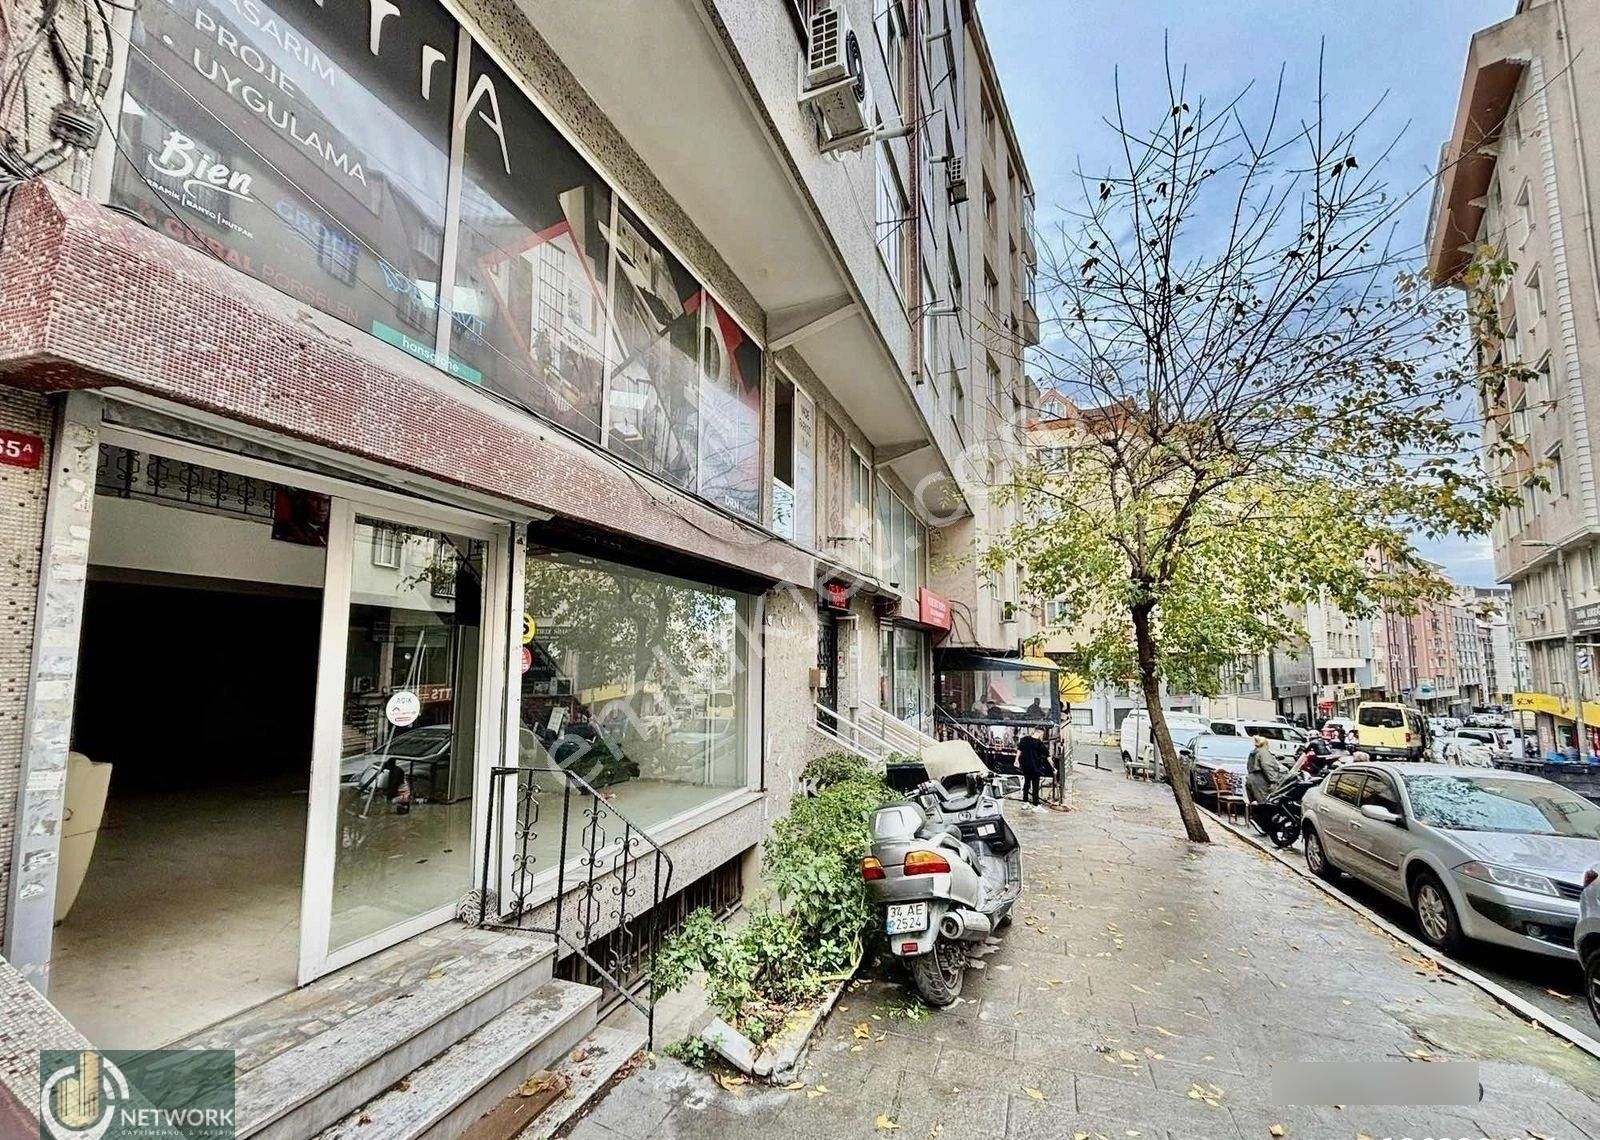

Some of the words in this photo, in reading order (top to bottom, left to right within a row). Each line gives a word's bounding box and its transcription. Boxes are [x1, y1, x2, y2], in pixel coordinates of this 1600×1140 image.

[194, 8, 296, 98] PROJE
[228, 0, 337, 87] SARIM
[193, 47, 368, 187] UYGULAMA
[147, 130, 254, 202] Bien
[262, 263, 360, 323] PORSELEN
[890, 906, 903, 918] 34
[907, 903, 924, 916] AE
[896, 917, 921, 930] 2524
